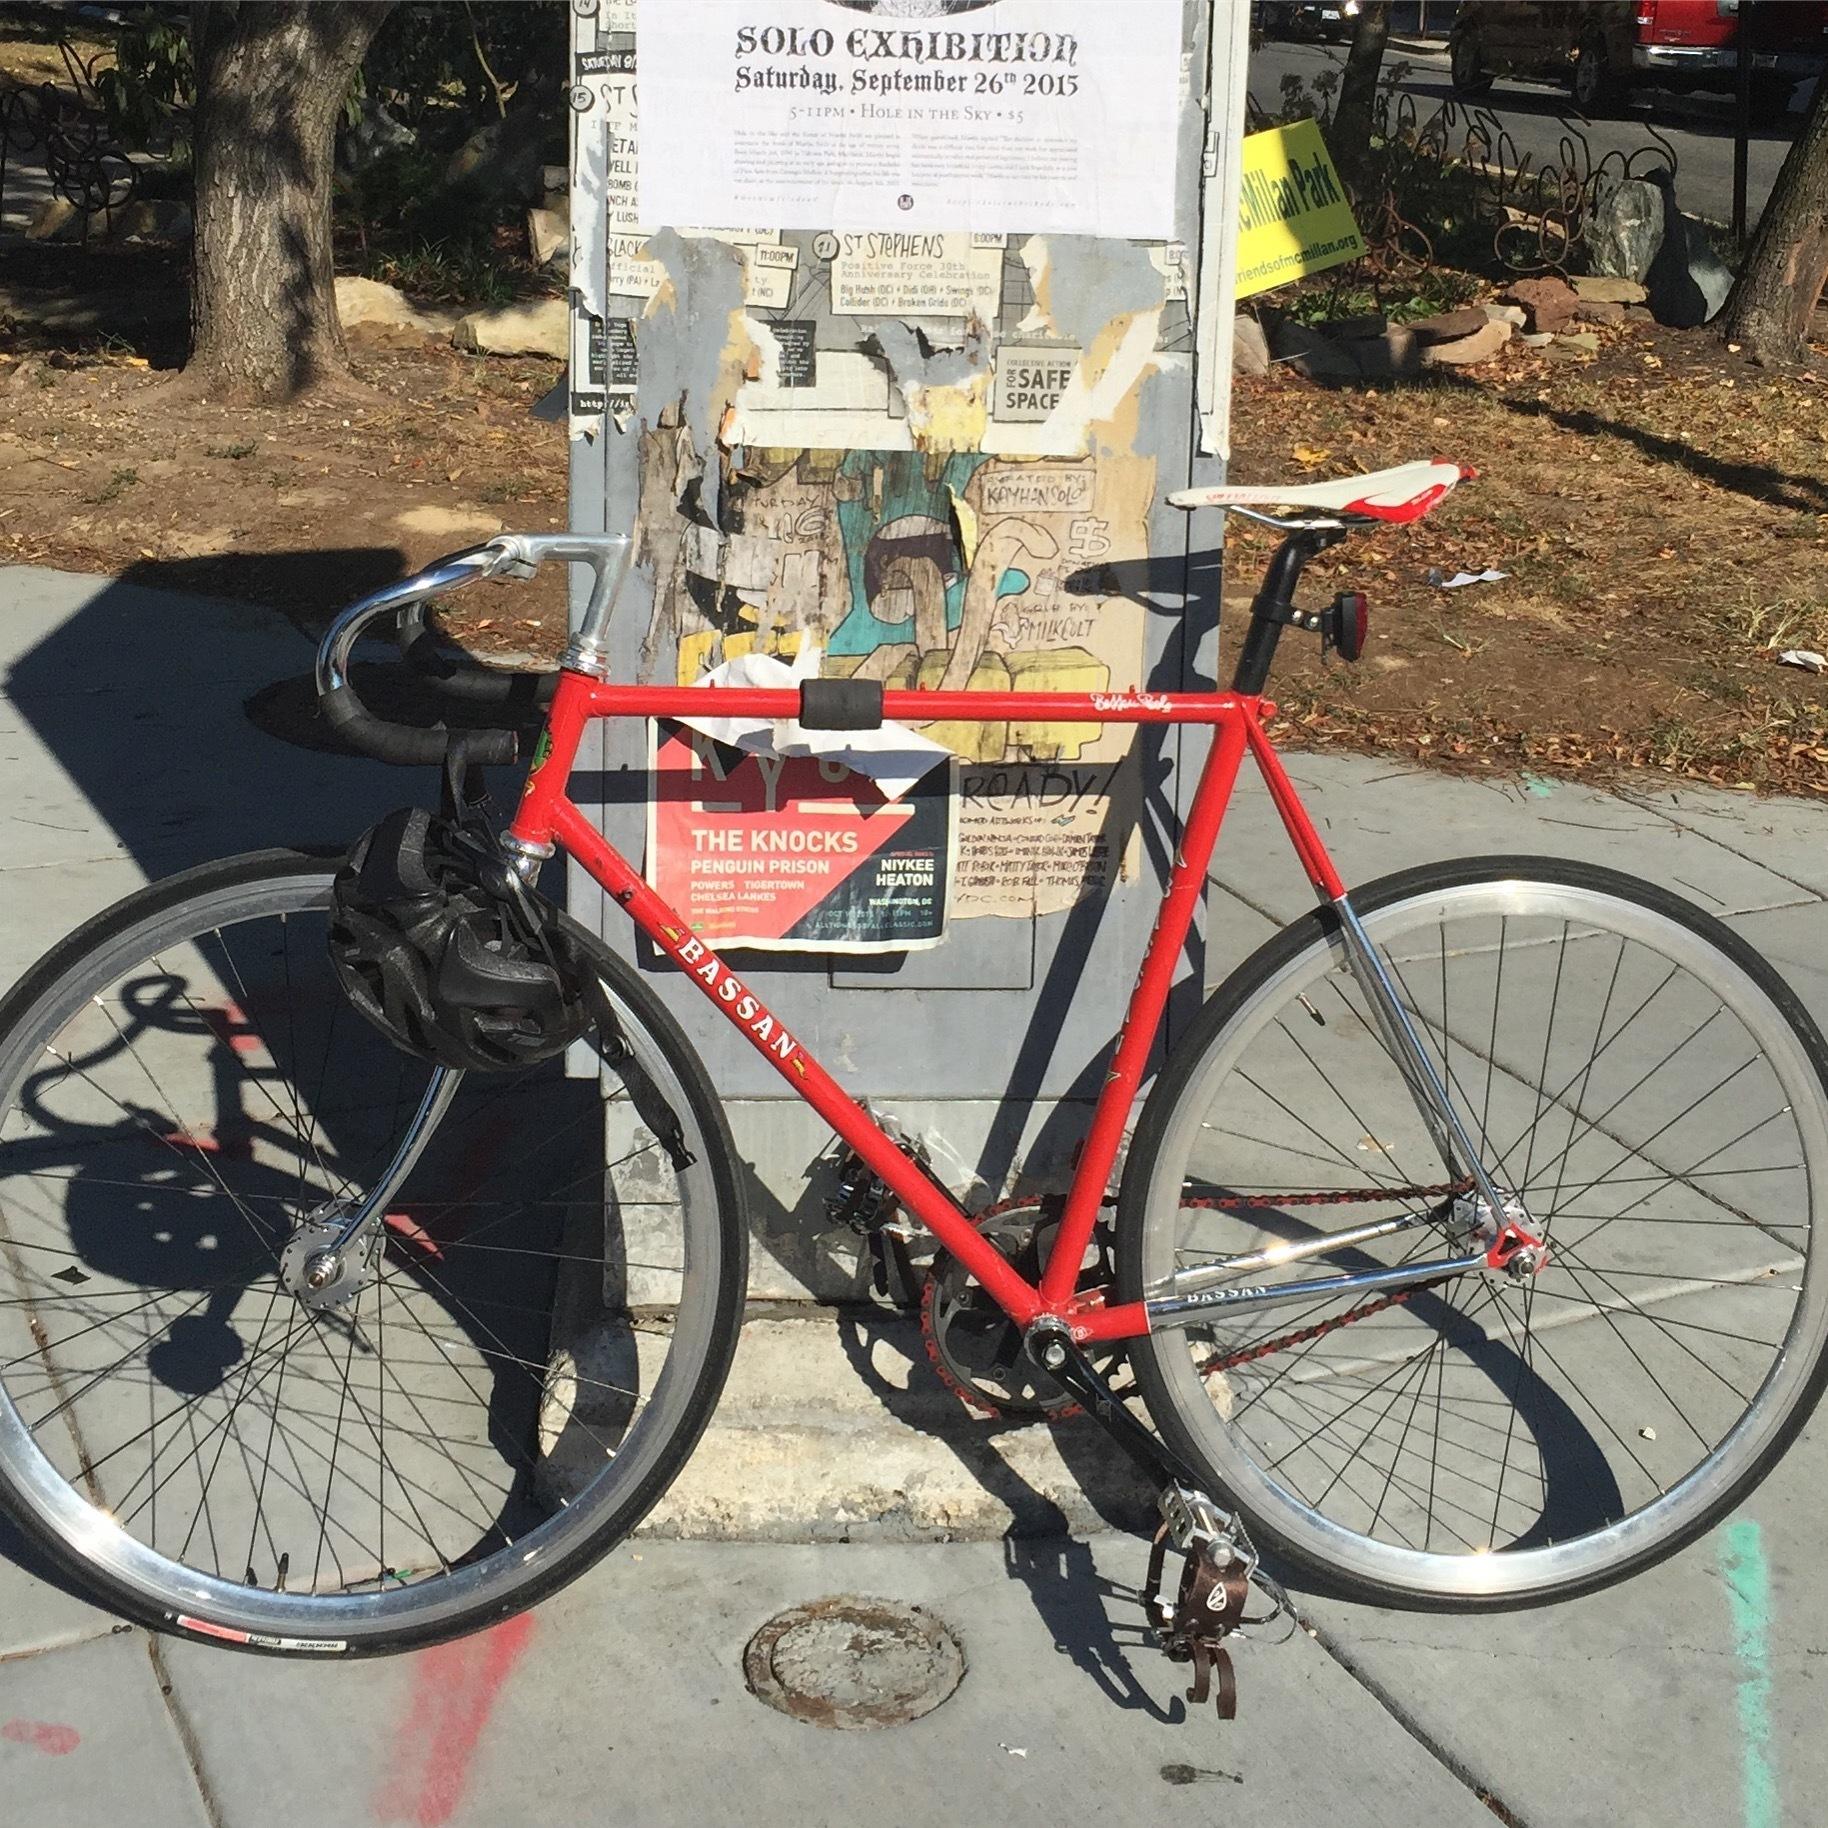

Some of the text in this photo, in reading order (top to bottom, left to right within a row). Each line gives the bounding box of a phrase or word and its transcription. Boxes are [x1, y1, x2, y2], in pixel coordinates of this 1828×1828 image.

[735, 26, 1078, 67] SOLO EXHIBITION
[851, 69, 967, 96] September
[1023, 73, 1079, 96] 2015
[572, 92, 586, 103] 15
[1240, 152, 1341, 232] cMillan Park
[901, 262, 933, 271] Force
[1235, 234, 1358, 284] riendsofmcmillan.org
[1006, 368, 1017, 388] FOR
[1018, 368, 1071, 390] SAFE
[1006, 392, 1060, 410] SPACE
[691, 829, 858, 853] THE KNOCKS
[691, 859, 830, 875] PENGUIN PRISON
[881, 859, 934, 872] NIYKEE
[691, 880, 805, 890] POWERS TIGERTOWN
[876, 873, 934, 887] HEATON
[677, 936, 798, 1060] BASSAN
[1187, 1285, 1267, 1304] BASSAN
